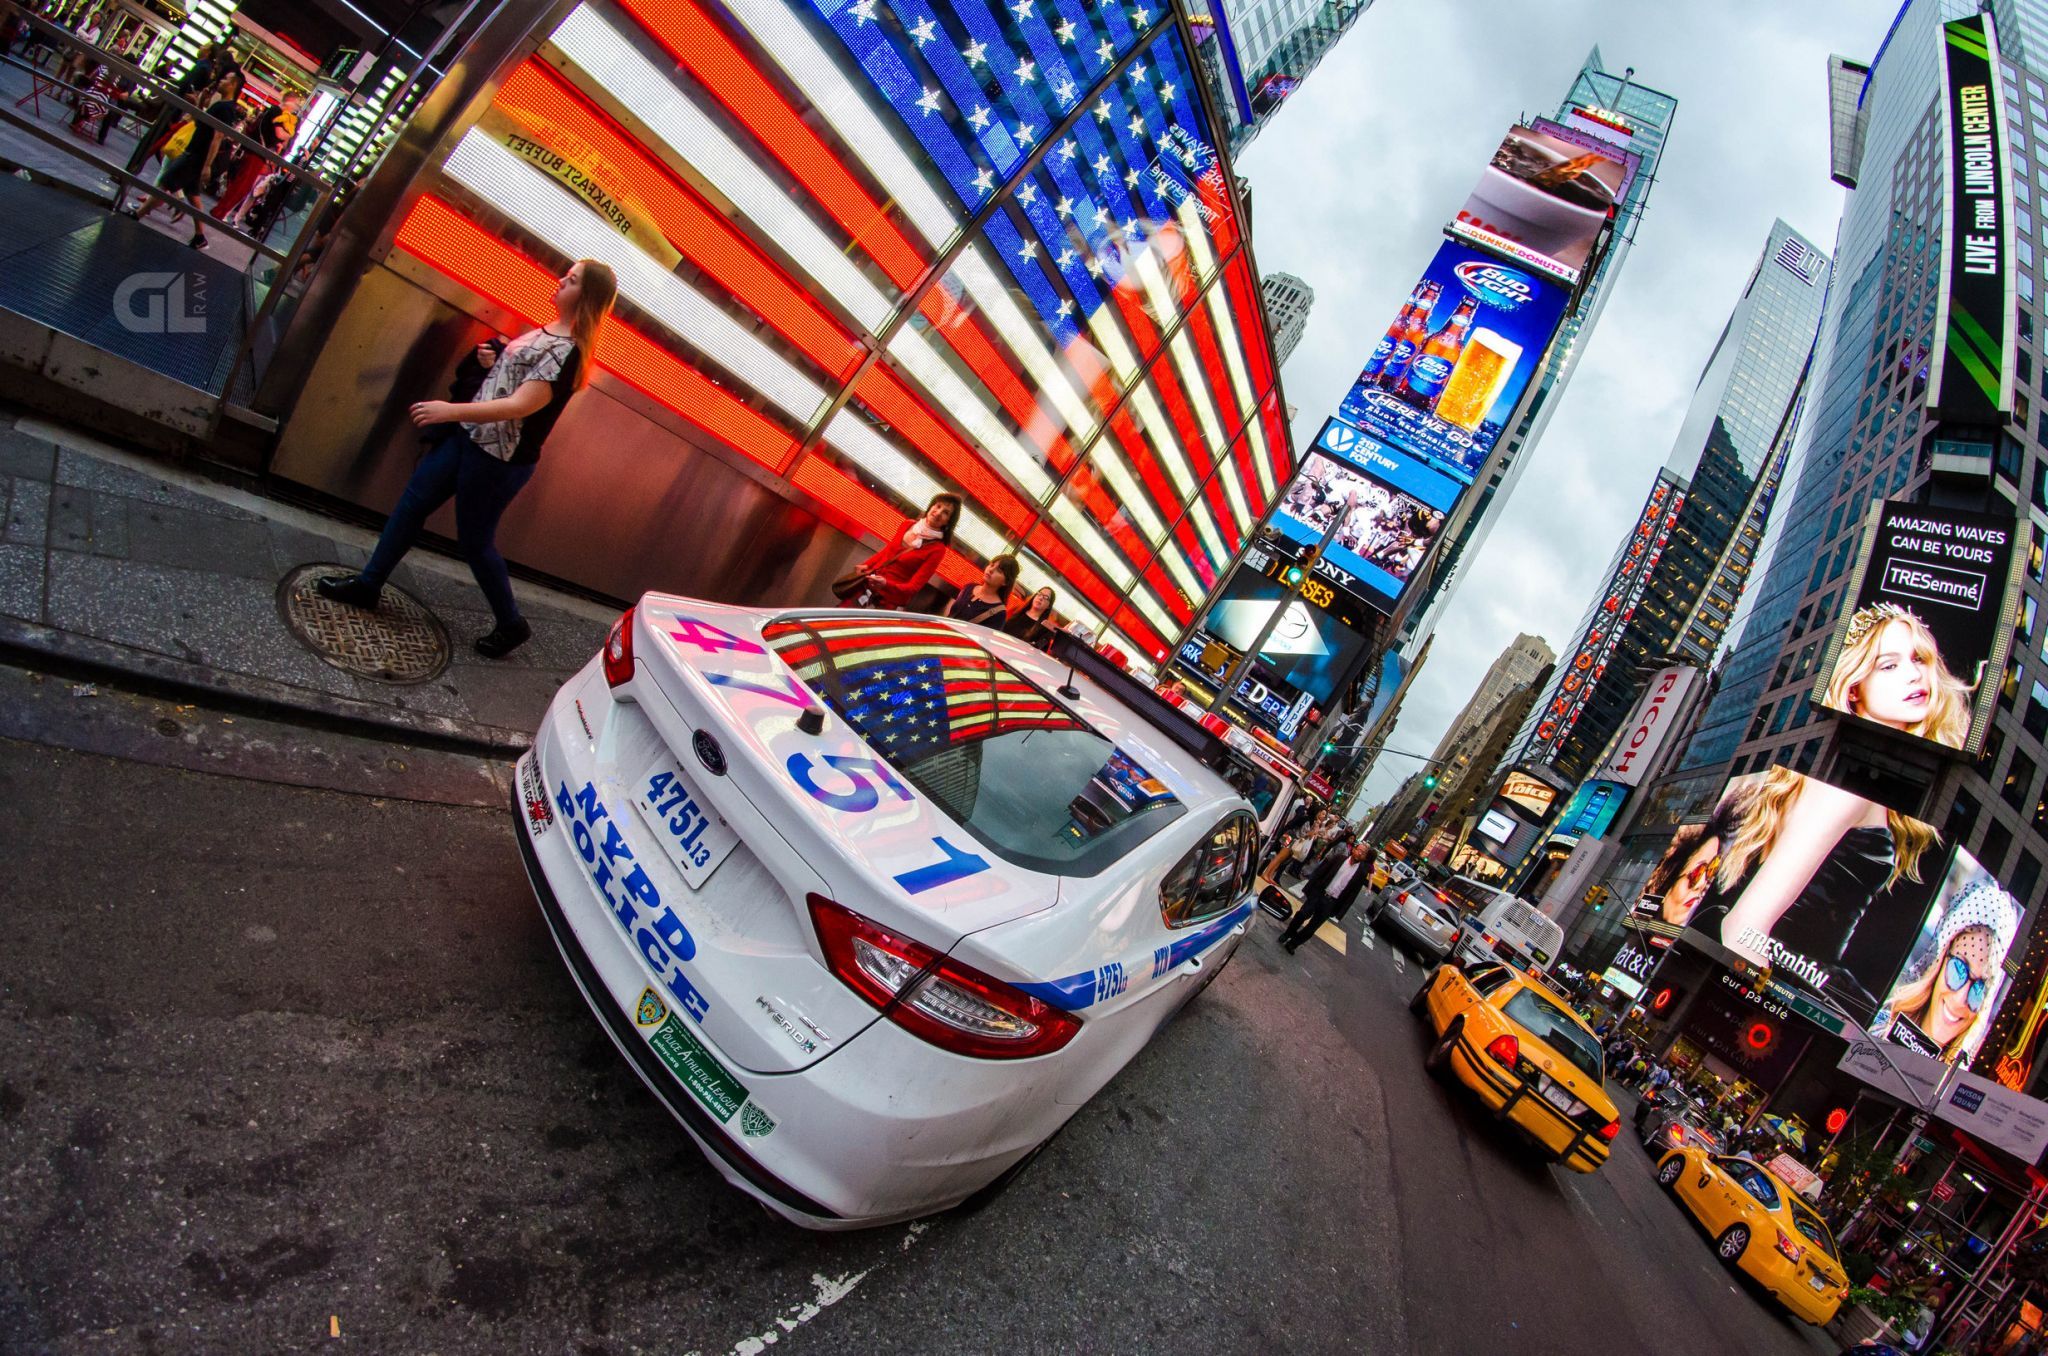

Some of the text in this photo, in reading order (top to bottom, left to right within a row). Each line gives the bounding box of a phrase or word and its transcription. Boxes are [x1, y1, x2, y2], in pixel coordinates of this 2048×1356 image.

[1586, 104, 1625, 126] 2014
[1960, 84, 1996, 275] LIVE FROM LINCOLN CENTER
[1469, 230, 1564, 275] DUNKIN' DONUTS
[1463, 271, 1533, 304] LIGHT
[1478, 267, 1531, 294] BUD
[1414, 360, 1449, 378] LIGHT
[1423, 355, 1449, 371] BUD
[1373, 395, 1473, 448] HERE WE GO
[1349, 452, 1370, 467] FOX
[1353, 444, 1399, 471] CENTURY
[1357, 437, 1382, 453] 21ST
[1622, 486, 1668, 576] ERNST
[1887, 516, 2006, 545] AMAZING WAVES
[1891, 535, 1993, 563] CAN BE YOURS
[1278, 565, 1334, 608] LSES
[1890, 567, 1979, 601] TRESemmé
[1538, 629, 1604, 740] YOUNG
[1284, 694, 1313, 732] NYPD
[1616, 673, 1678, 773] RICOH
[697, 739, 723, 765] Ford
[647, 771, 710, 852] 4751
[575, 781, 697, 962] NYPD
[1570, 850, 1588, 875] REUTERS
[556, 780, 710, 1024] POLICE
[1737, 926, 1830, 989] #TRESmbfw
[1098, 962, 1123, 1002] 4751
[1722, 975, 1788, 1020] europa café
[756, 996, 804, 1043] HYBRID
[1805, 1006, 1813, 1015] 7
[653, 1038, 679, 1069] palnyc.org
[687, 1075, 730, 1119] 1-800-PAL-4KIDS
[1953, 1096, 1978, 1110] YOUNG
[1957, 1087, 1983, 1101] AVISON
[749, 1111, 764, 1128] PAL
